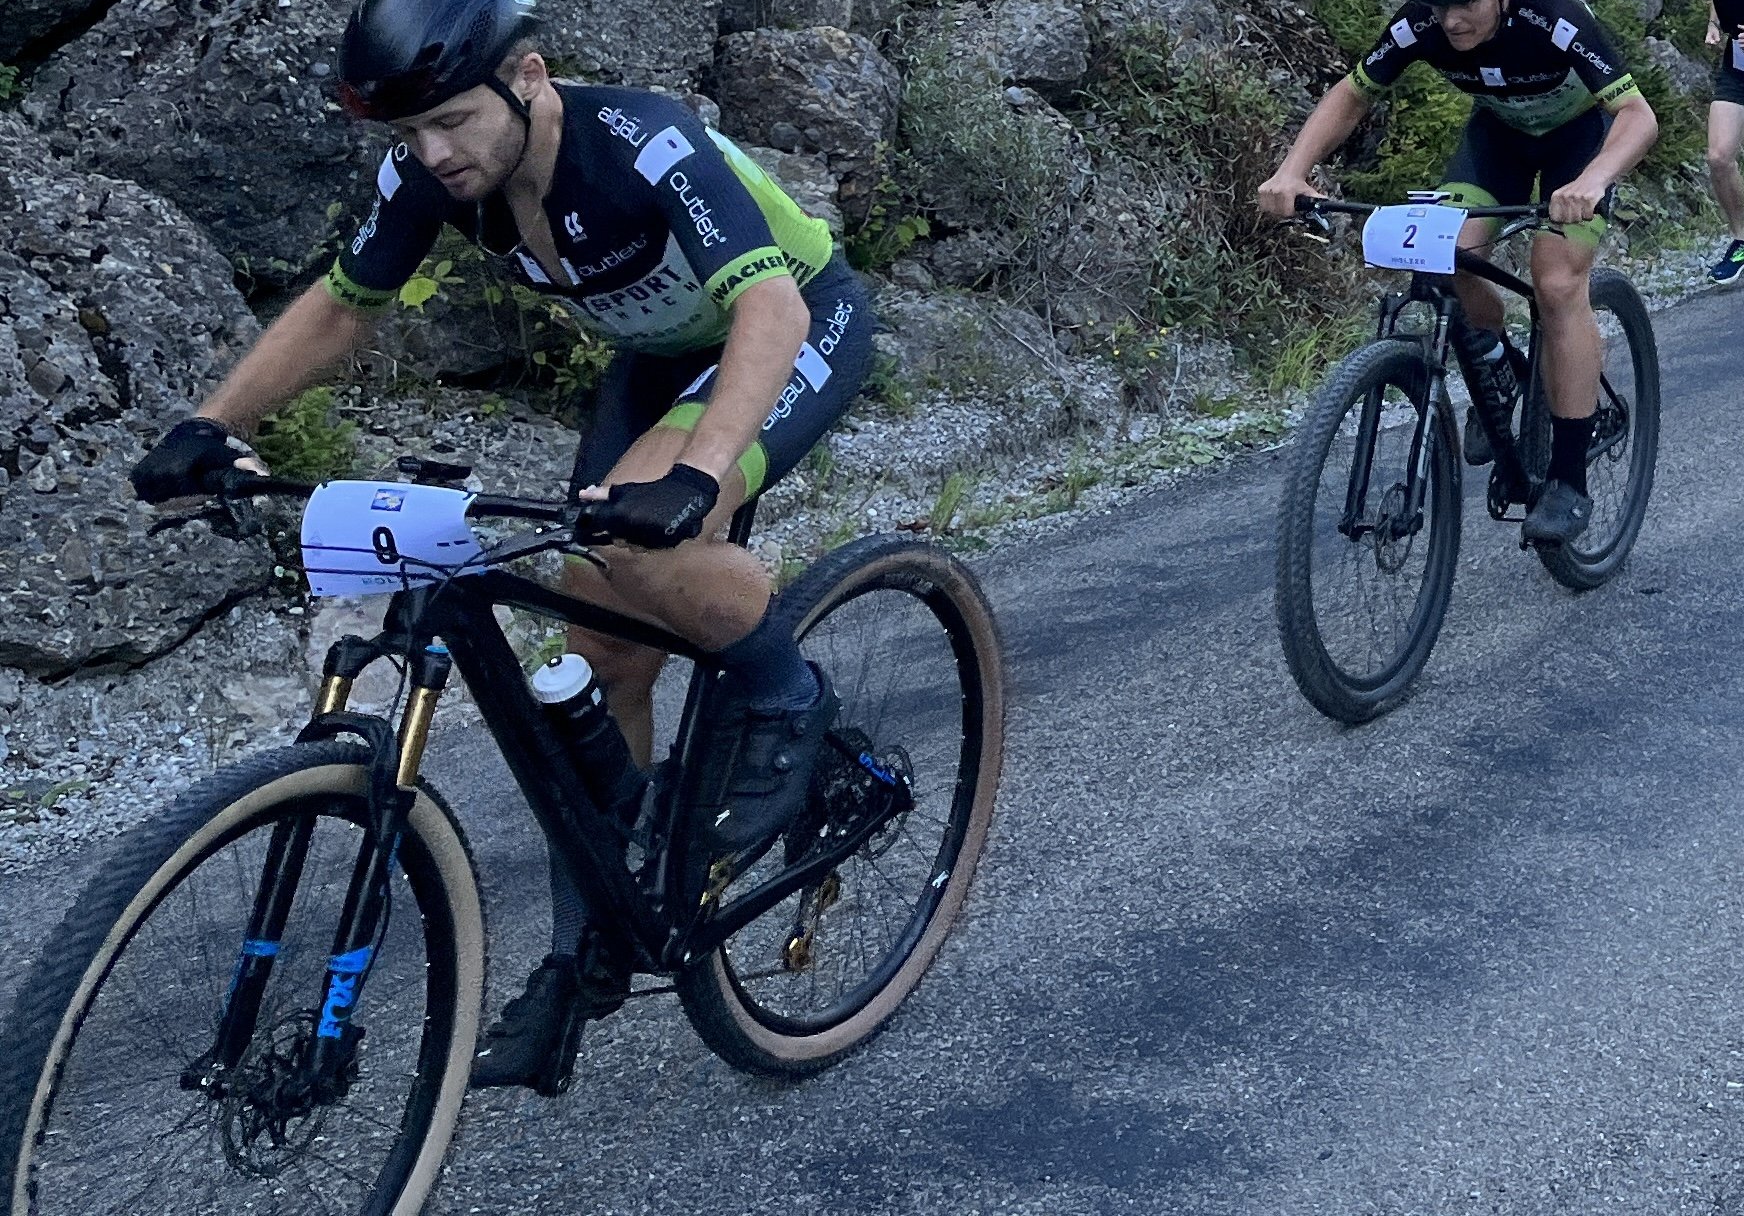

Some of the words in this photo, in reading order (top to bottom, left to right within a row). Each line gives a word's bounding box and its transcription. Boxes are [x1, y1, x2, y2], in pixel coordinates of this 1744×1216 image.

[669, 171, 726, 248] outlet
[578, 236, 648, 277] outlet
[1402, 223, 1419, 249] 2
[590, 264, 682, 312] SPORT
[372, 526, 401, 565] 9
